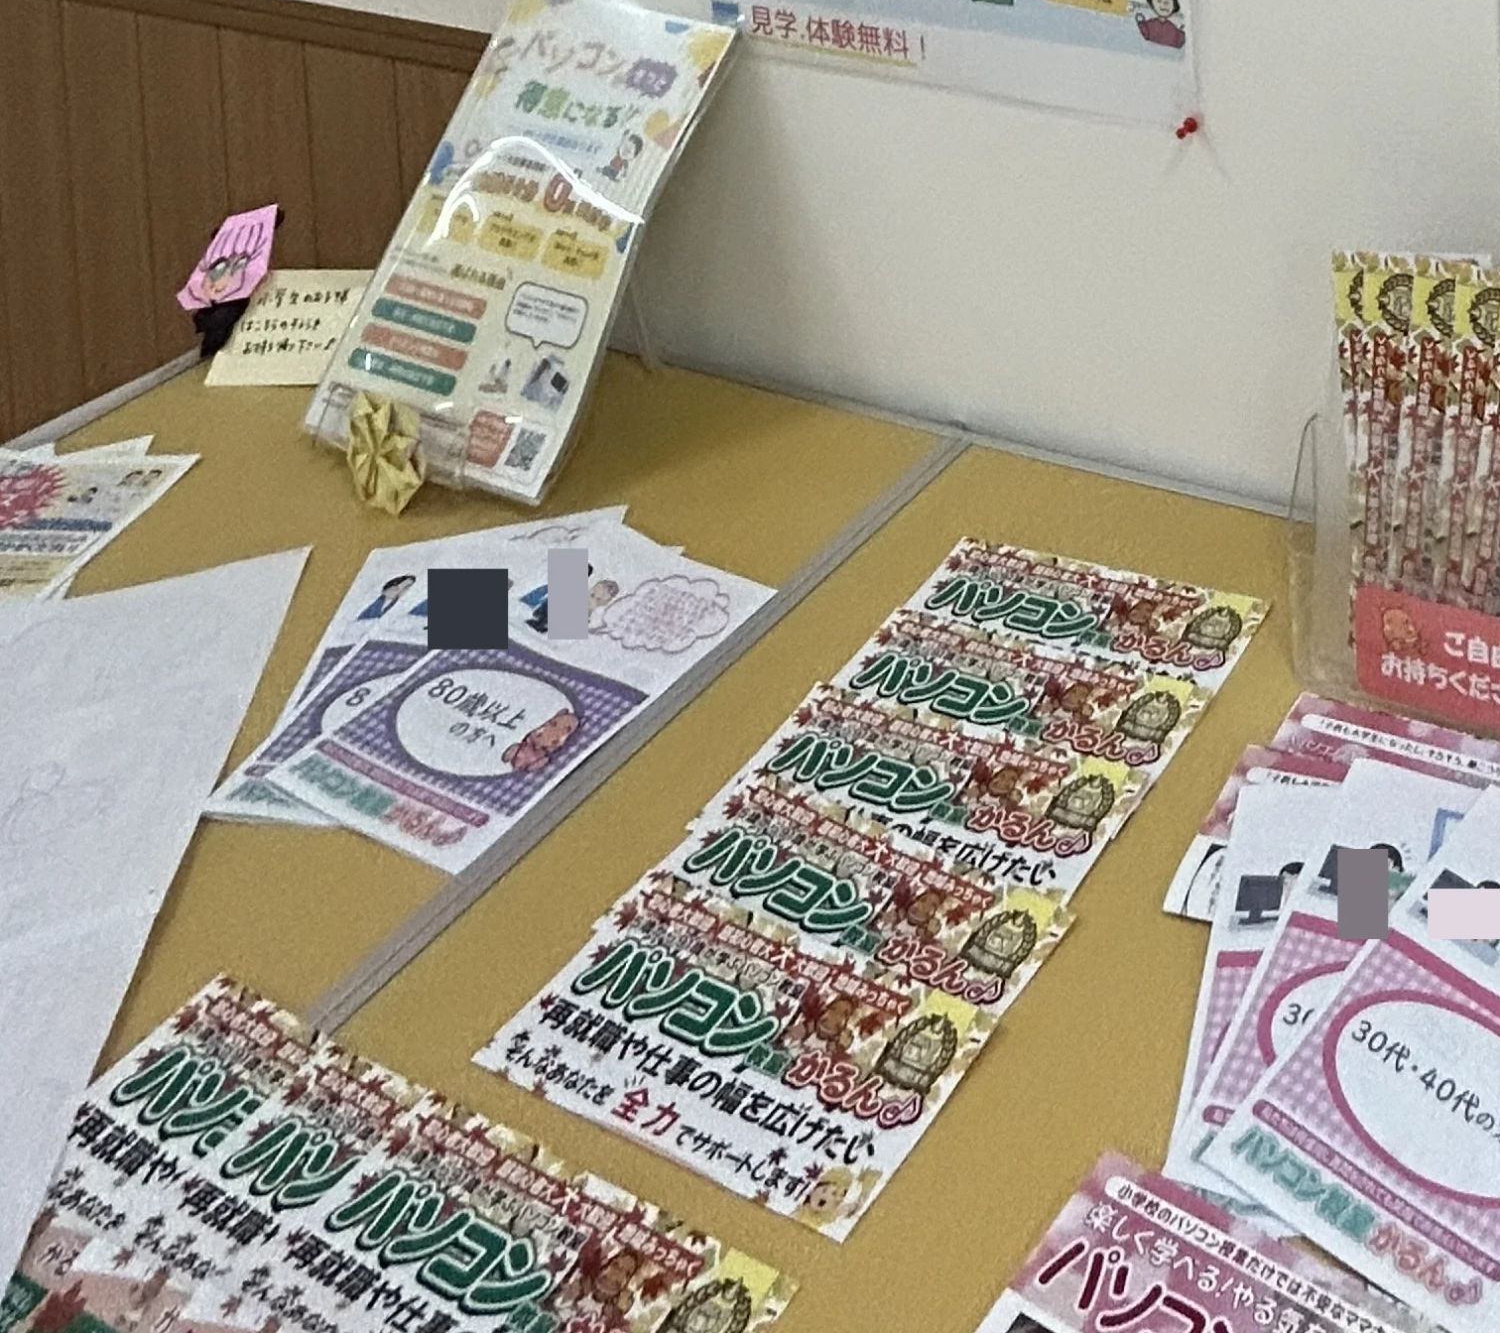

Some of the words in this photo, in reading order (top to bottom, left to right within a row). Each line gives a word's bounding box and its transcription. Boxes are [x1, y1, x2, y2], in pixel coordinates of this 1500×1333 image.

[925, 576, 1098, 638] パソコン
[427, 677, 526, 731] 80歳以上
[850, 652, 1031, 726] パソコン
[766, 733, 955, 814] パソコン
[682, 827, 873, 935] パソコン
[571, 934, 780, 1057] パソコン
[539, 999, 876, 1165] 再就職や仕事の幅を広げたい
[324, 1167, 553, 1315] パソコン
[1037, 1240, 1240, 1333] パソコ
